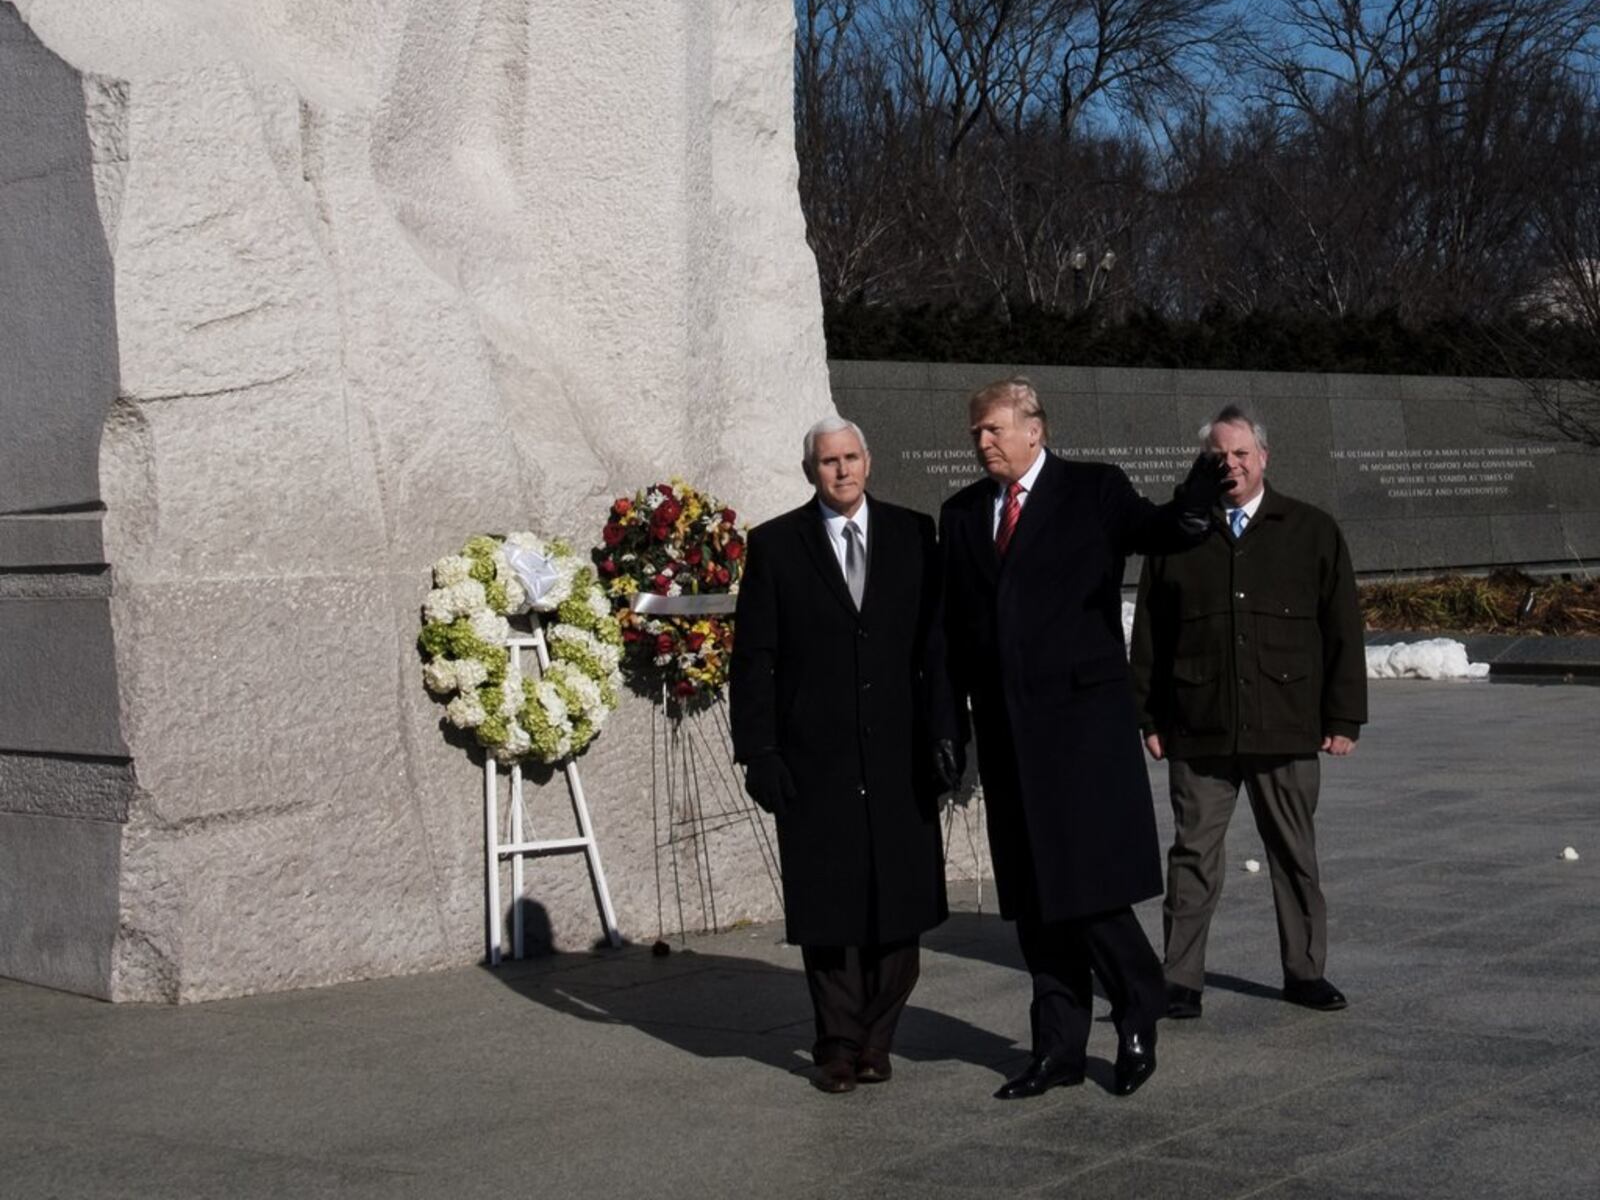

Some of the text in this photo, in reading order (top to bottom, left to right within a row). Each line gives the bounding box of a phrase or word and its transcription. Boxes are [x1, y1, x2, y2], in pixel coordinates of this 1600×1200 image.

[902, 451, 910, 459] IT
[912, 450, 921, 458] IS
[922, 450, 942, 458] NOT
[943, 449, 976, 458] ENOUG
[1062, 448, 1079, 456] NOT
[1081, 448, 1105, 456] WAGE
[1135, 447, 1143, 455] IT
[1144, 446, 1153, 455] IS
[1330, 450, 1345, 458] THE
[1386, 449, 1422, 457] MEASURE
[1423, 449, 1433, 457] OF
[1441, 448, 1460, 456] MAN
[927, 464, 948, 473] LOVE
[951, 464, 976, 472] PEACE
[1359, 463, 1369, 471] IN
[1370, 462, 1411, 471] MOMENTS
[1424, 461, 1460, 470] COMFORT
[1462, 461, 1480, 469] AND
[1144, 474, 1159, 482] BUT
[1161, 474, 1175, 482] ON
[1387, 488, 1433, 497] CHALLENGE
[1435, 487, 1453, 496] AND
